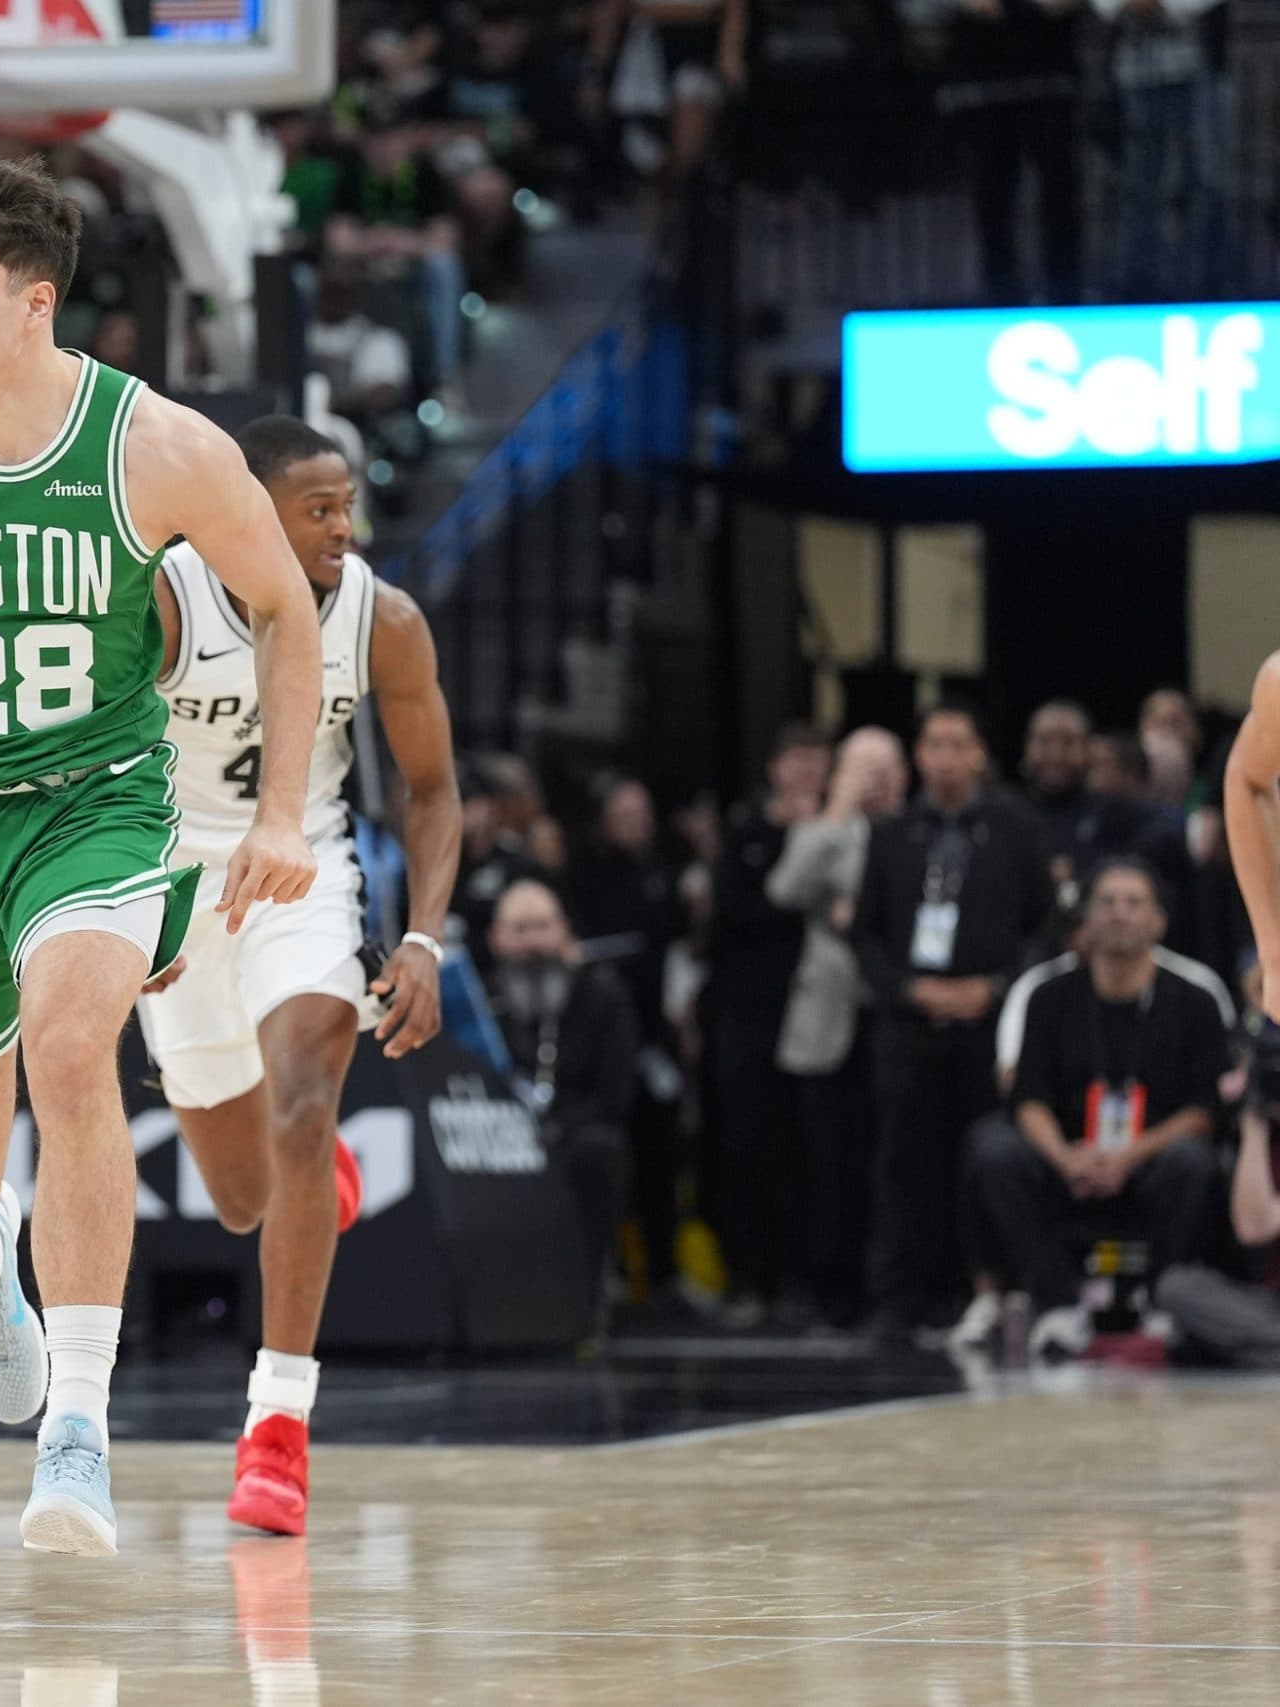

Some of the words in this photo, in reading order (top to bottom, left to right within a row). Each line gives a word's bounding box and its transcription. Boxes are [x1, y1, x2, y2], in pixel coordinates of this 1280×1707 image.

[986, 313, 1263, 458] Self
[44, 479, 102, 496] Amica
[172, 696, 357, 730] SPS
